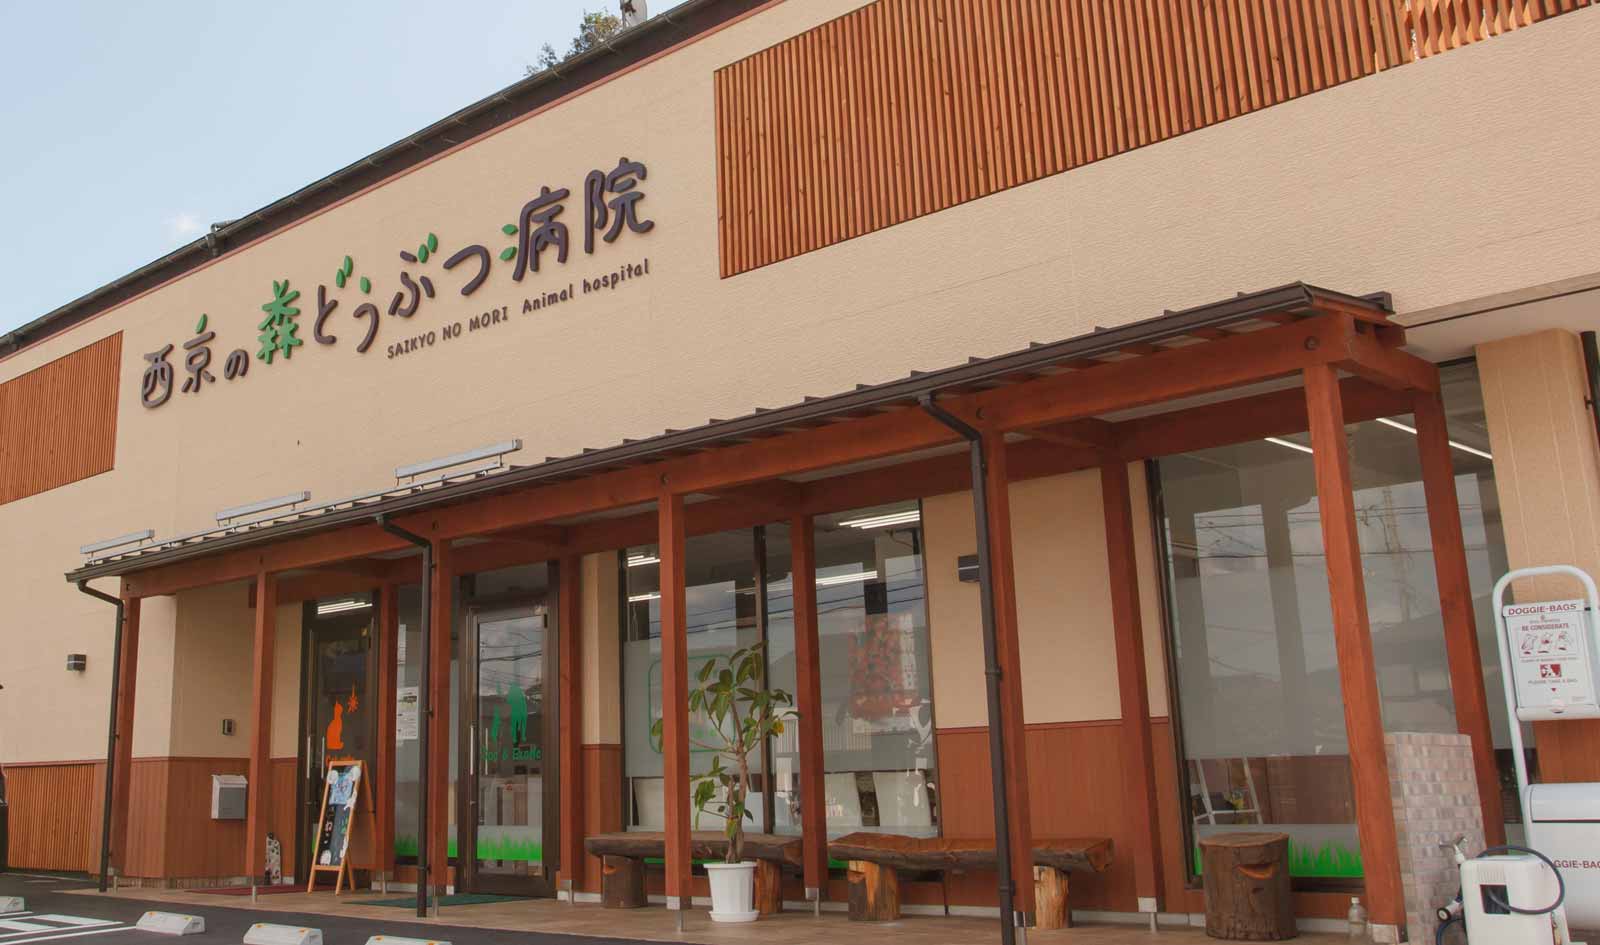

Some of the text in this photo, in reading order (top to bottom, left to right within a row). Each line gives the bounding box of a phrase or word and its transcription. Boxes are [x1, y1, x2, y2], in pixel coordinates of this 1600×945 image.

[140, 156, 655, 410] 西京の森どうぶつ病院
[387, 258, 650, 360] SAIKYO NO MORI Animal hospital
[1508, 603, 1577, 616] DOGGIE-BAGS
